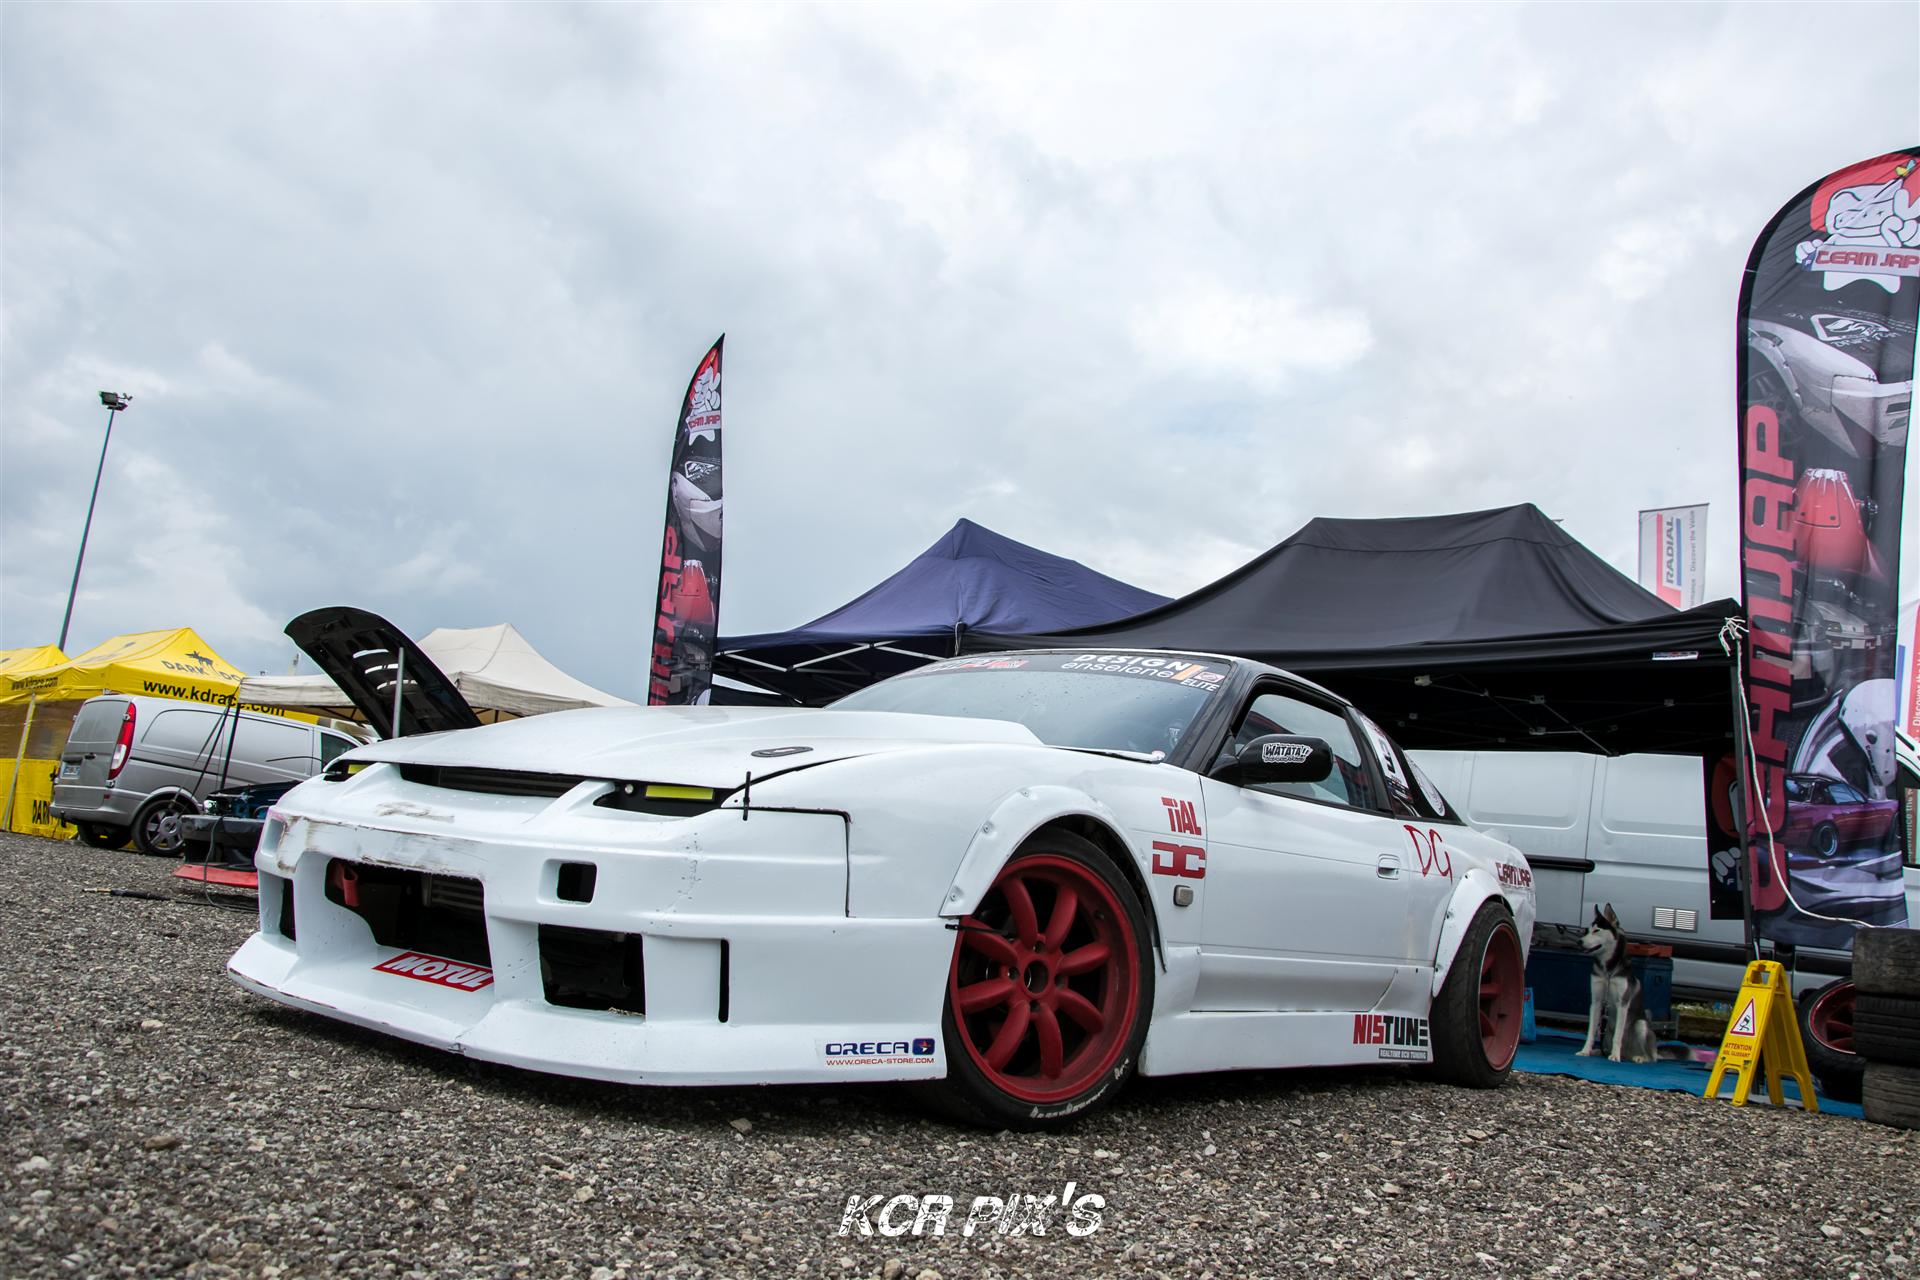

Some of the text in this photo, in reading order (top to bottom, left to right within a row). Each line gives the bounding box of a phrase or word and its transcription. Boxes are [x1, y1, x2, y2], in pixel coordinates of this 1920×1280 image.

[1815, 250, 1919, 269] TEAM JAP
[1745, 404, 1795, 599] JAP
[1665, 517, 1674, 584] RADIAL
[161, 659, 209, 676] DARK
[1061, 661, 1175, 678] enseigne
[1073, 654, 1190, 671] DESIGN
[1180, 678, 1220, 692] ELITE
[383, 955, 494, 988] MOTUL
[1353, 1014, 1428, 1047] NISTUNE
[825, 1042, 909, 1056] ORECA
[1725, 1042, 1753, 1051] ATTENTION
[826, 1057, 935, 1066] WWW.ORECA-STORE.COM
